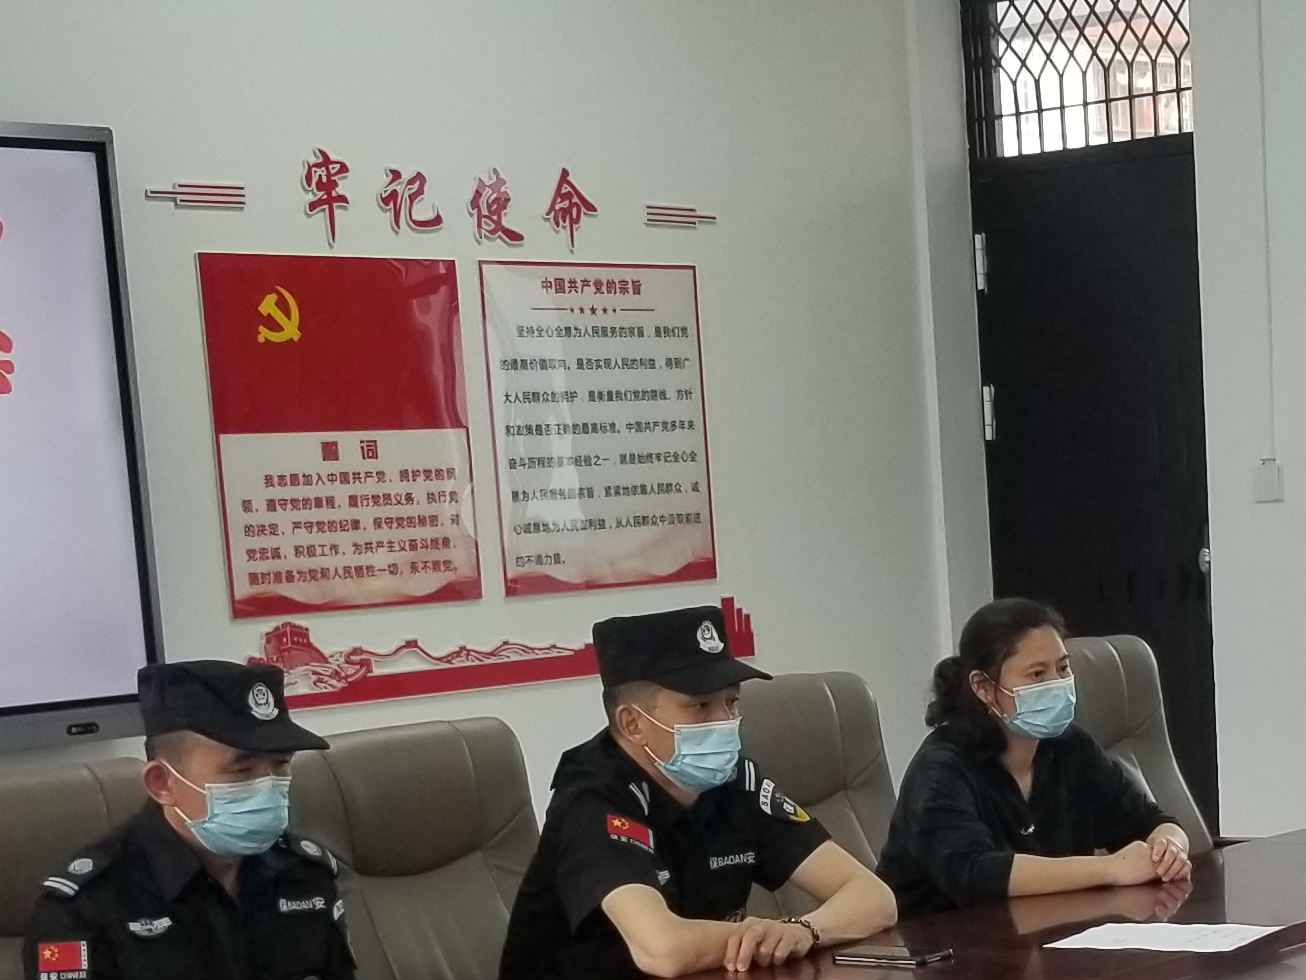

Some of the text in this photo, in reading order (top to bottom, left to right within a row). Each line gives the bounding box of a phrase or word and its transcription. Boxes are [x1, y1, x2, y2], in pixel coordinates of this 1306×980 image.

[303, 147, 599, 251] 牢记使命
[541, 277, 641, 295] 中国共产党的宗旨
